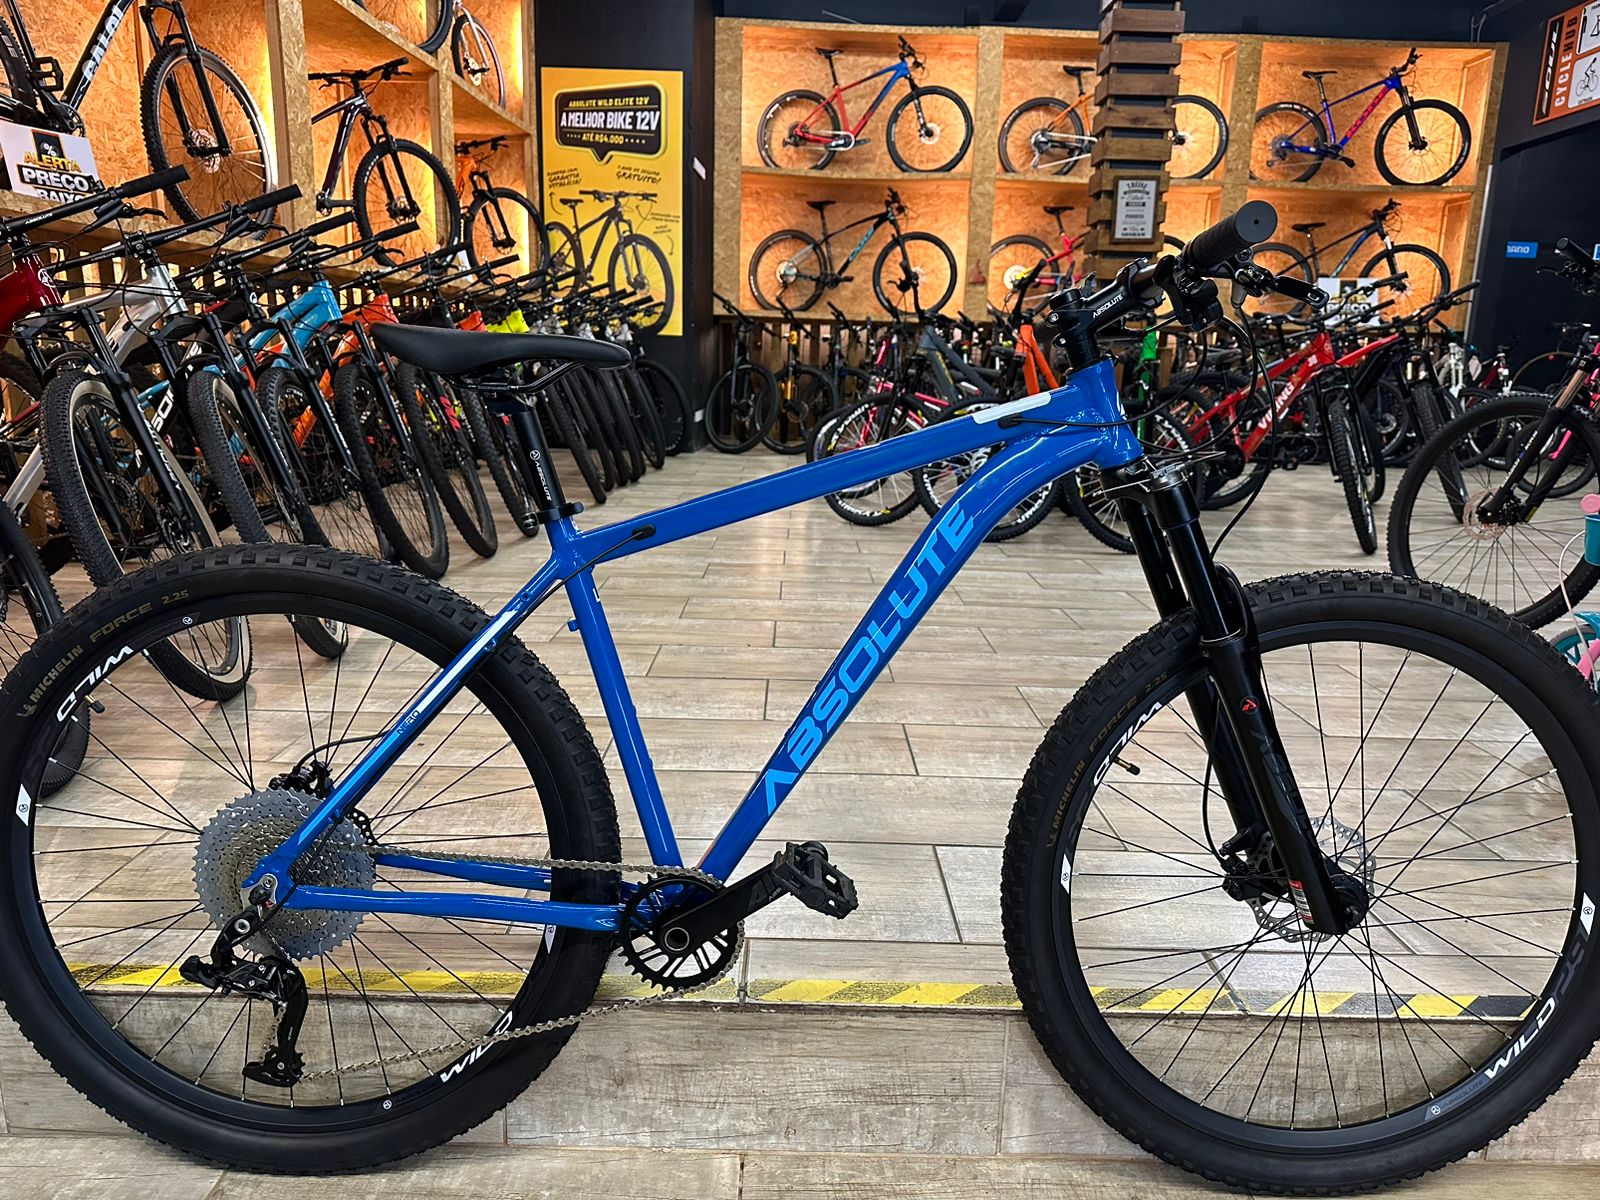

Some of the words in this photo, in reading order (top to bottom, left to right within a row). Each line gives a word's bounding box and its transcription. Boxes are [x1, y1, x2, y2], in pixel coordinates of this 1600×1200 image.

[560, 112, 567, 127] A
[568, 111, 605, 128] MELHOR
[606, 111, 634, 130] BIKE
[636, 110, 660, 131] 12V
[614, 97, 635, 106] ELITE
[635, 96, 650, 105] 12V
[22, 167, 89, 193] PREÇO
[24, 151, 82, 173] ALERTA
[1092, 293, 1124, 319] ABSOLUTE
[533, 460, 552, 502] ABSOLUTE
[29, 644, 85, 702] MICHELIN
[89, 602, 153, 643] FORCE
[161, 589, 190, 605] 2.25
[766, 502, 977, 817] ABSOLUTE
[56, 645, 134, 723] WILD
[1052, 759, 1086, 829] MICHELIN
[1088, 695, 1138, 753] FORCE
[1093, 700, 1163, 787] WILD
[440, 1010, 513, 1084] WILD
[1483, 997, 1556, 1080] WILD
